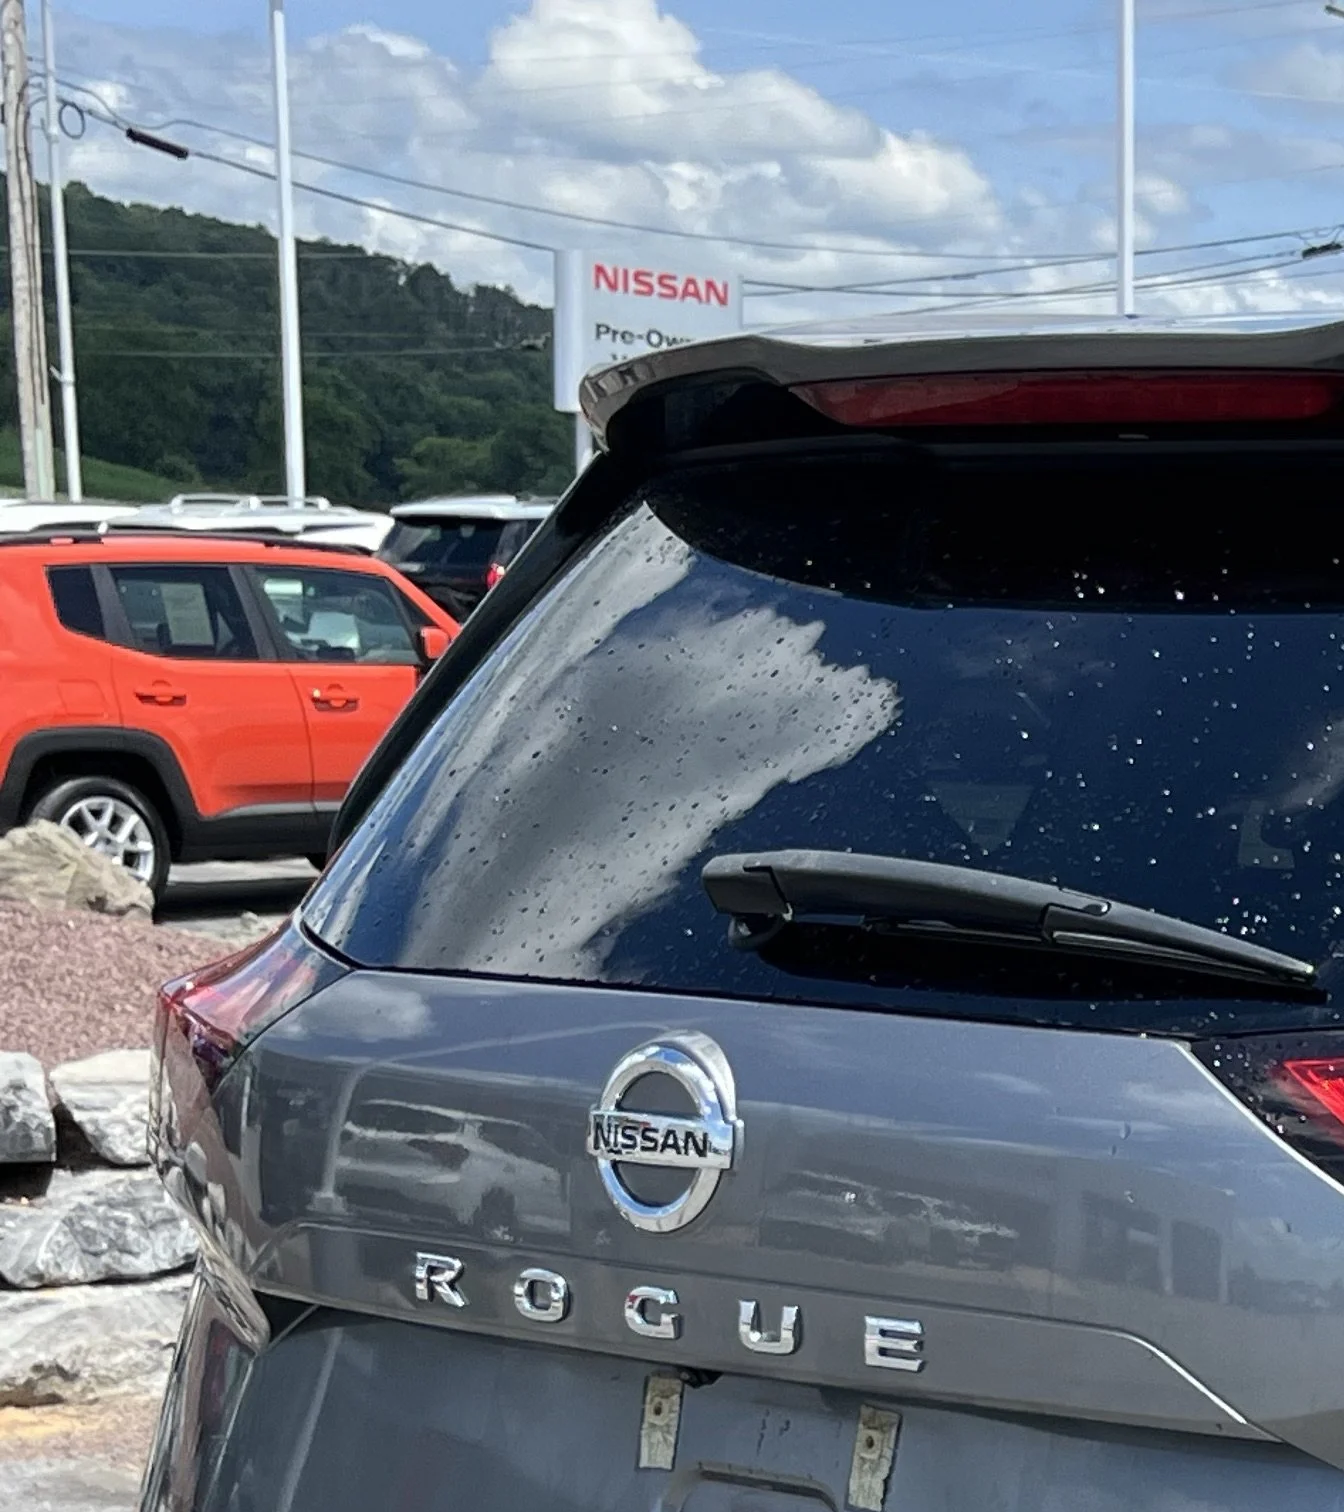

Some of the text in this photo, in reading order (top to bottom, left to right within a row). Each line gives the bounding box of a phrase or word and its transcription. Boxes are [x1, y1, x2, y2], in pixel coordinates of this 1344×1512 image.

[593, 263, 729, 307] NISSAN
[595, 323, 692, 348] Pre-Ow
[593, 1120, 709, 1158] NISSAN
[413, 1251, 926, 1372] ROGUE
